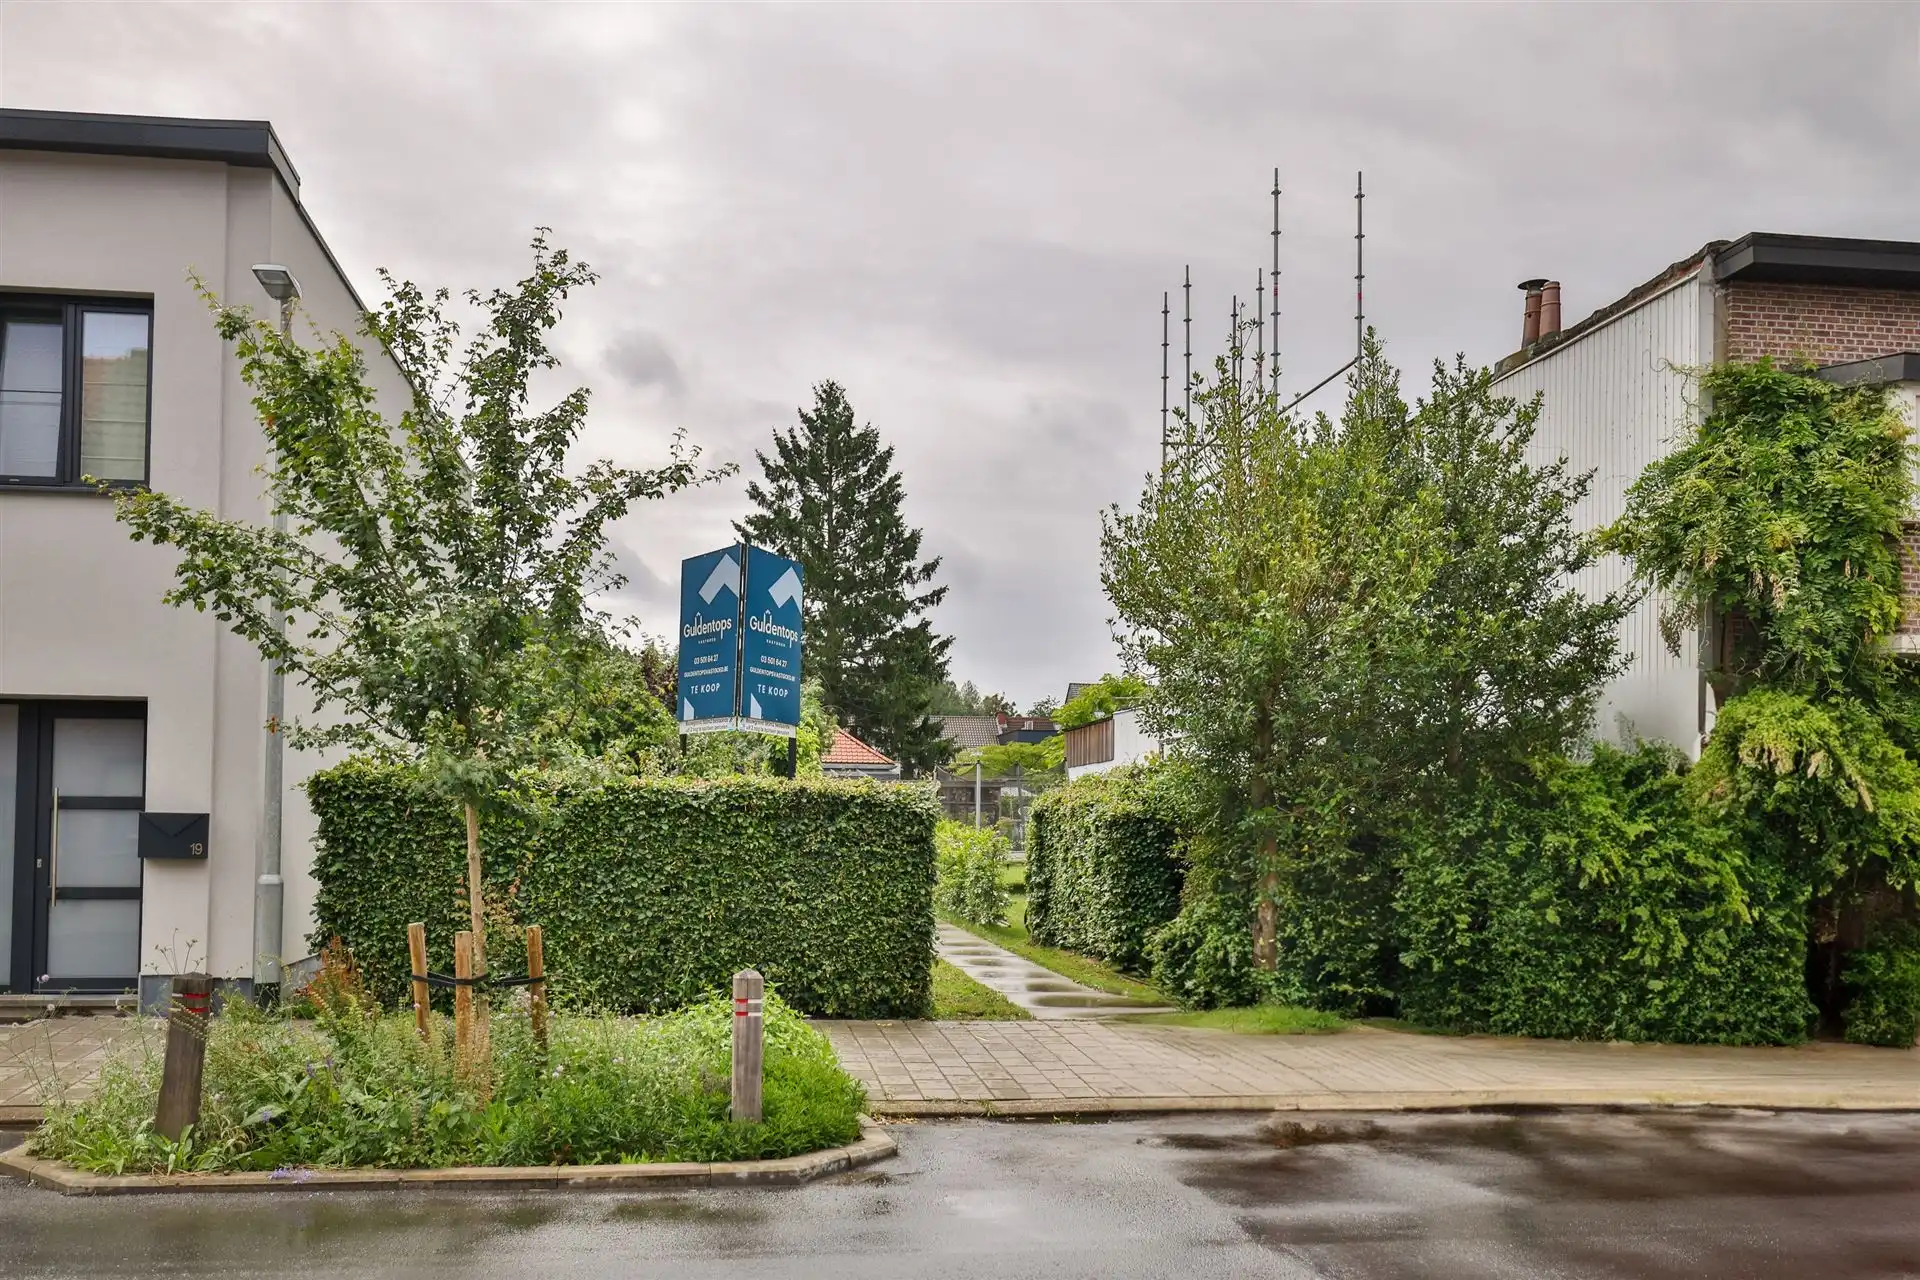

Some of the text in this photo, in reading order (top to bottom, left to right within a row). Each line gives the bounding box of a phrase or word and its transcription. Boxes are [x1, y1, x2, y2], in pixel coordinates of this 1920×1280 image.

[684, 614, 732, 640] Guldentops
[749, 613, 799, 648] Guldentops
[693, 657, 700, 665] 03
[760, 655, 767, 663] 03
[691, 683, 721, 694] TE KOOP
[757, 684, 789, 698] TE KOOP
[190, 843, 203, 855] 19
